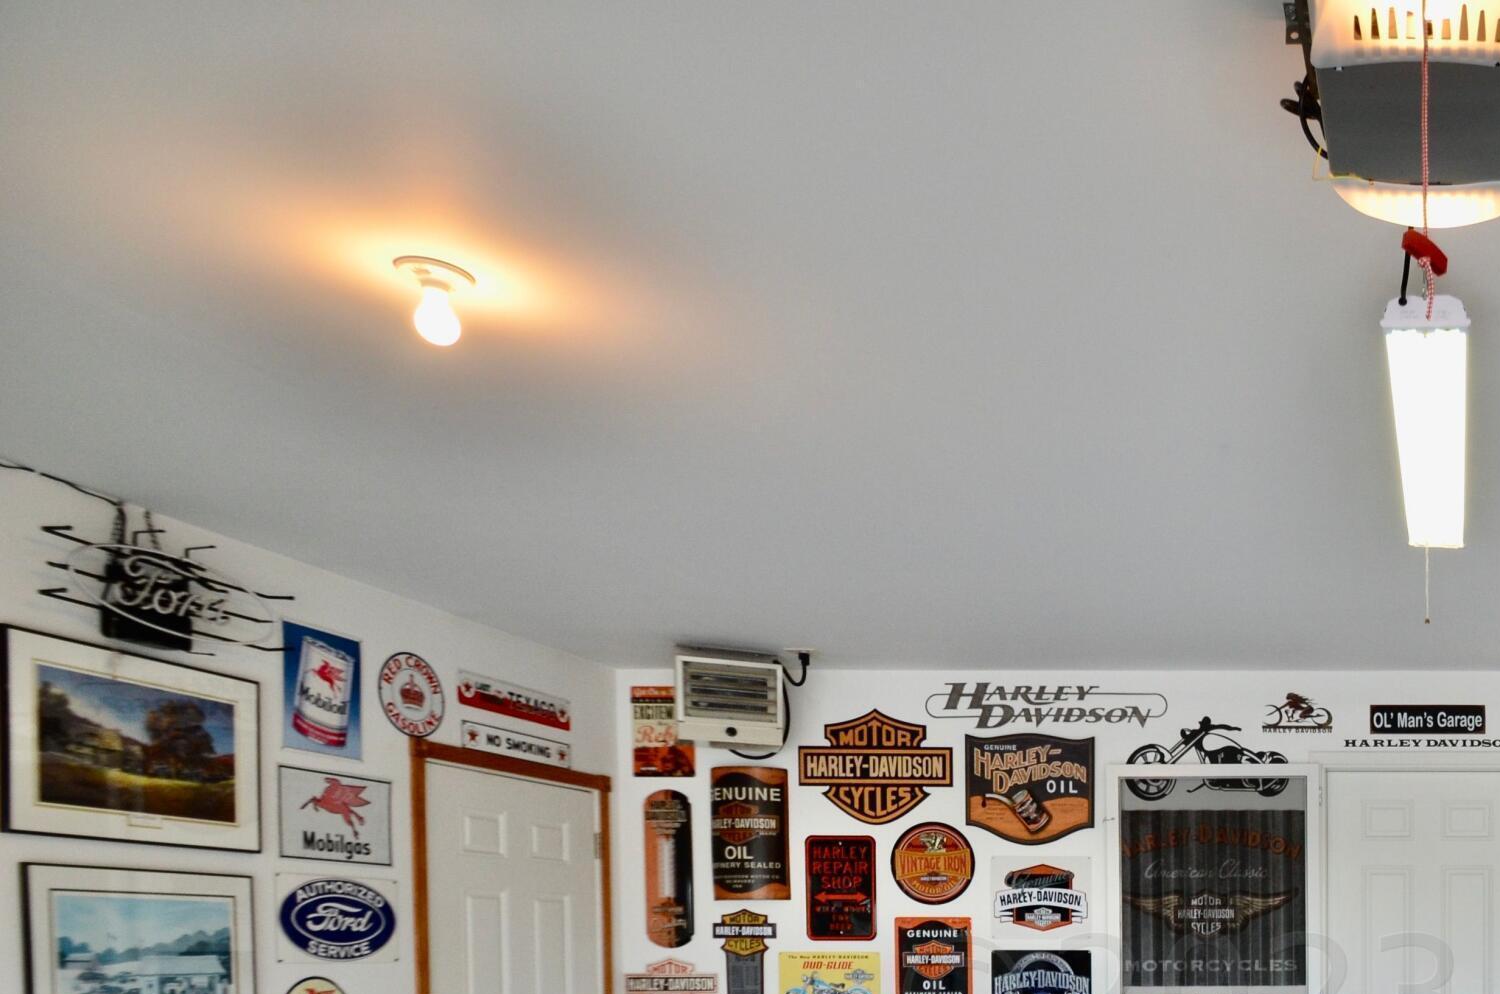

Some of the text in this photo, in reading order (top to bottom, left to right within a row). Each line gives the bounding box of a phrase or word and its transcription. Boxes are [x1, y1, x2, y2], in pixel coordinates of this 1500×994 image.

[383, 655, 441, 695] RED CROWN
[943, 682, 1100, 710] HARLEY
[386, 701, 441, 735] GASOLINE
[975, 704, 1153, 729] DAVIDSON
[1397, 711, 1434, 729] Man's
[1437, 711, 1483, 732] Garage
[839, 720, 912, 747] MOTOR
[486, 733, 552, 759] NO SMOKING
[984, 743, 1017, 751] GENUINE
[1343, 738, 1422, 748] HARLEY
[806, 754, 944, 779] HARLEY-DAVIDSON
[991, 760, 1088, 795] DAVIDSON
[1045, 779, 1079, 795] OIL
[840, 786, 912, 818] CYCLES
[302, 830, 372, 860] Mobilgas
[724, 845, 755, 860] OIL
[812, 845, 869, 859] HARLEY
[743, 861, 782, 870] SEALED
[812, 861, 869, 875] REPAIR
[899, 851, 968, 875] VINTAGE IRON
[820, 875, 863, 889] SHOP
[296, 880, 386, 910] AUTHORIZED
[999, 890, 1082, 907] HARLEY-DAVIDSON
[1190, 894, 1223, 907] MOTOR
[305, 901, 374, 933] Ford
[1177, 908, 1236, 920] HARLEY-DAVIDSON
[715, 925, 773, 936] HARLEY-DAVIDSON
[906, 929, 958, 938] GENUINE
[307, 940, 372, 960] SERVICE
[726, 939, 762, 949] CYCLES
[906, 954, 961, 965] HARLEY-DAVIDSON
[1124, 959, 1299, 973] MOTORCYCLES
[922, 980, 946, 990] OIL
